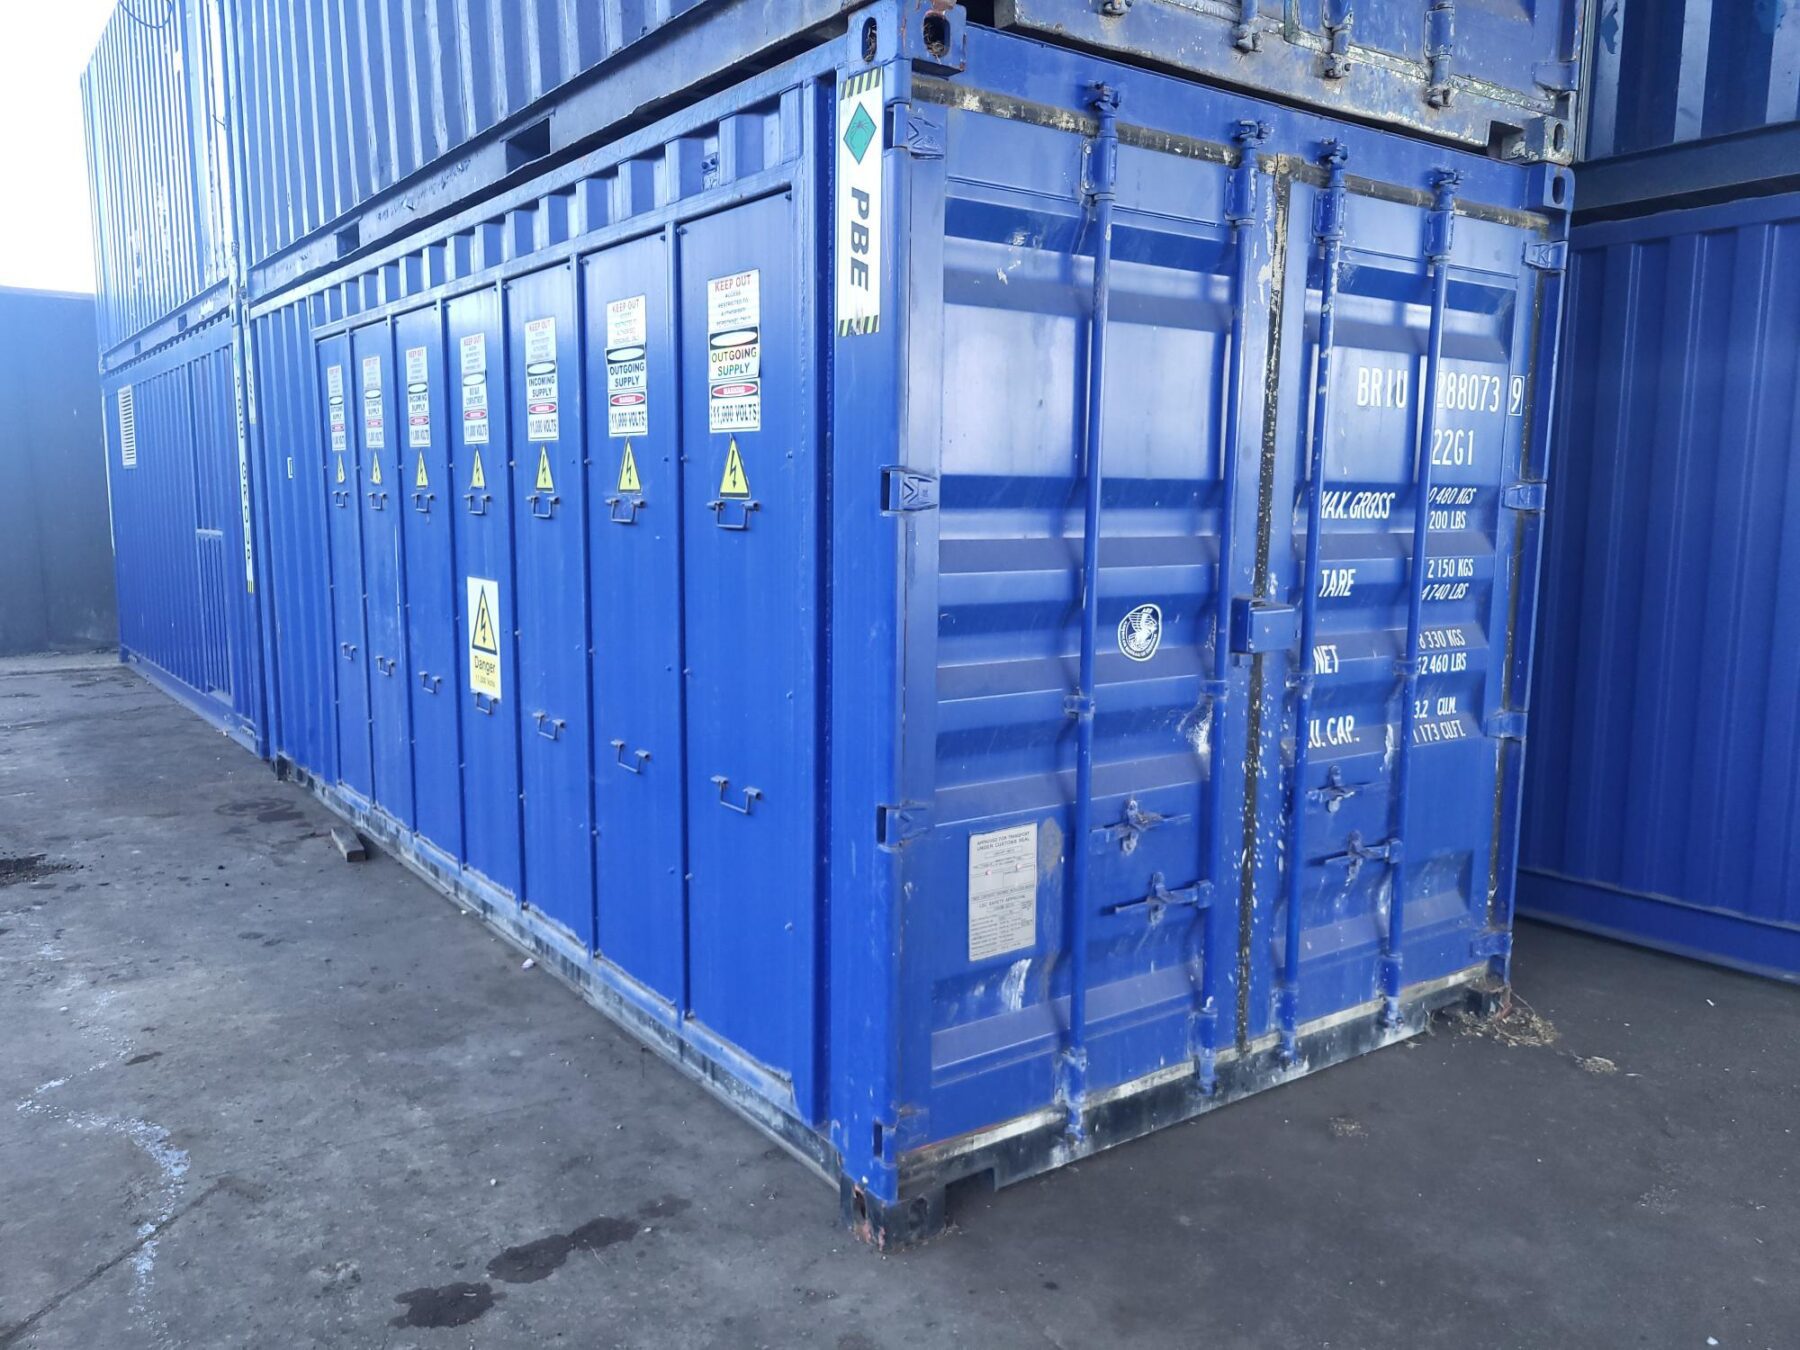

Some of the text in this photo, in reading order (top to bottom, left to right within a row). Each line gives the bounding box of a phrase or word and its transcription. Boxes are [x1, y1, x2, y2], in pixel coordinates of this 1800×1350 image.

[850, 187, 869, 291] PBE
[714, 274, 751, 292] KEEP OUT
[612, 298, 639, 313] KEEP OUT
[711, 347, 757, 363] OUTGOING
[610, 362, 644, 376] OUTGOING
[718, 362, 750, 377] SUPPLY
[529, 376, 555, 387] INCOMING
[615, 375, 640, 387] SUPPLY
[1357, 367, 1522, 413] BRIU 288073 9
[532, 387, 552, 397] SUPPLY
[735, 403, 757, 422] VOLTS
[1432, 429, 1474, 466] 22G1
[1436, 487, 1458, 504] 480
[1455, 487, 1477, 504] KGS
[1349, 492, 1396, 519] GROSS
[1450, 511, 1466, 529] LBS
[1427, 558, 1474, 578] 2 150 KGS
[1319, 569, 1356, 597] TARE
[1428, 583, 1450, 600] 740
[1448, 582, 1469, 600] LBS
[1425, 631, 1446, 648] 330
[1446, 629, 1466, 647] KGS
[475, 655, 496, 676] Danger
[1313, 645, 1339, 674] NET
[1429, 654, 1448, 674] 460
[1451, 652, 1467, 671] LBS
[1308, 715, 1360, 748] U. CAP.
[1419, 723, 1440, 742] 173
